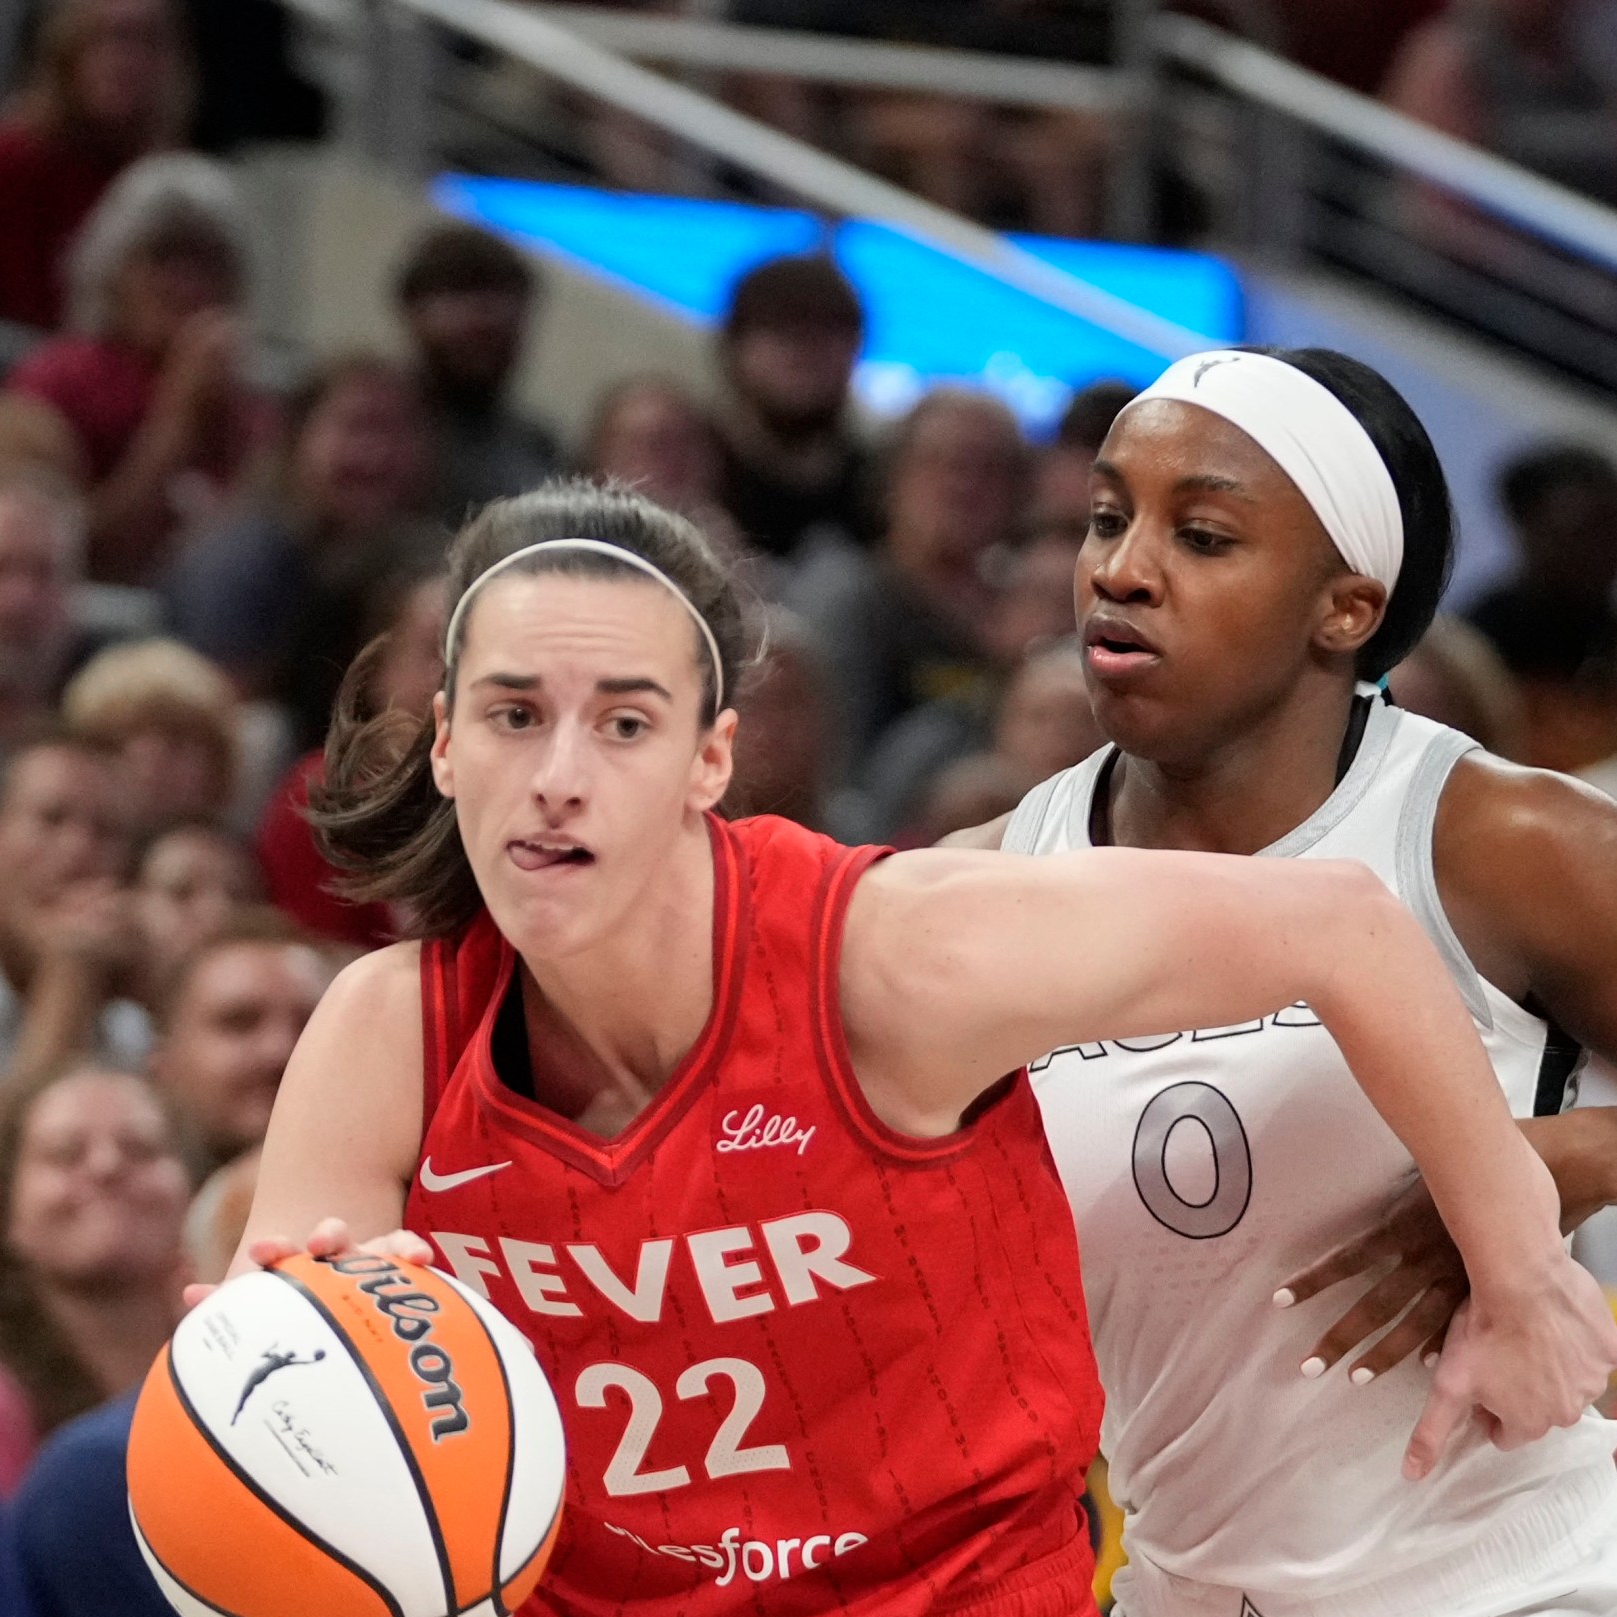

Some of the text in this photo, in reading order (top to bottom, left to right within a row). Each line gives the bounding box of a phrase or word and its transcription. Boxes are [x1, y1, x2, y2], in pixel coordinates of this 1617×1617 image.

[716, 1103, 816, 1155] Lilly
[1131, 1080, 1253, 1241] 0
[429, 1208, 883, 1324] FEVER
[574, 1357, 791, 1497] 22
[603, 1521, 869, 1587] lesforce
